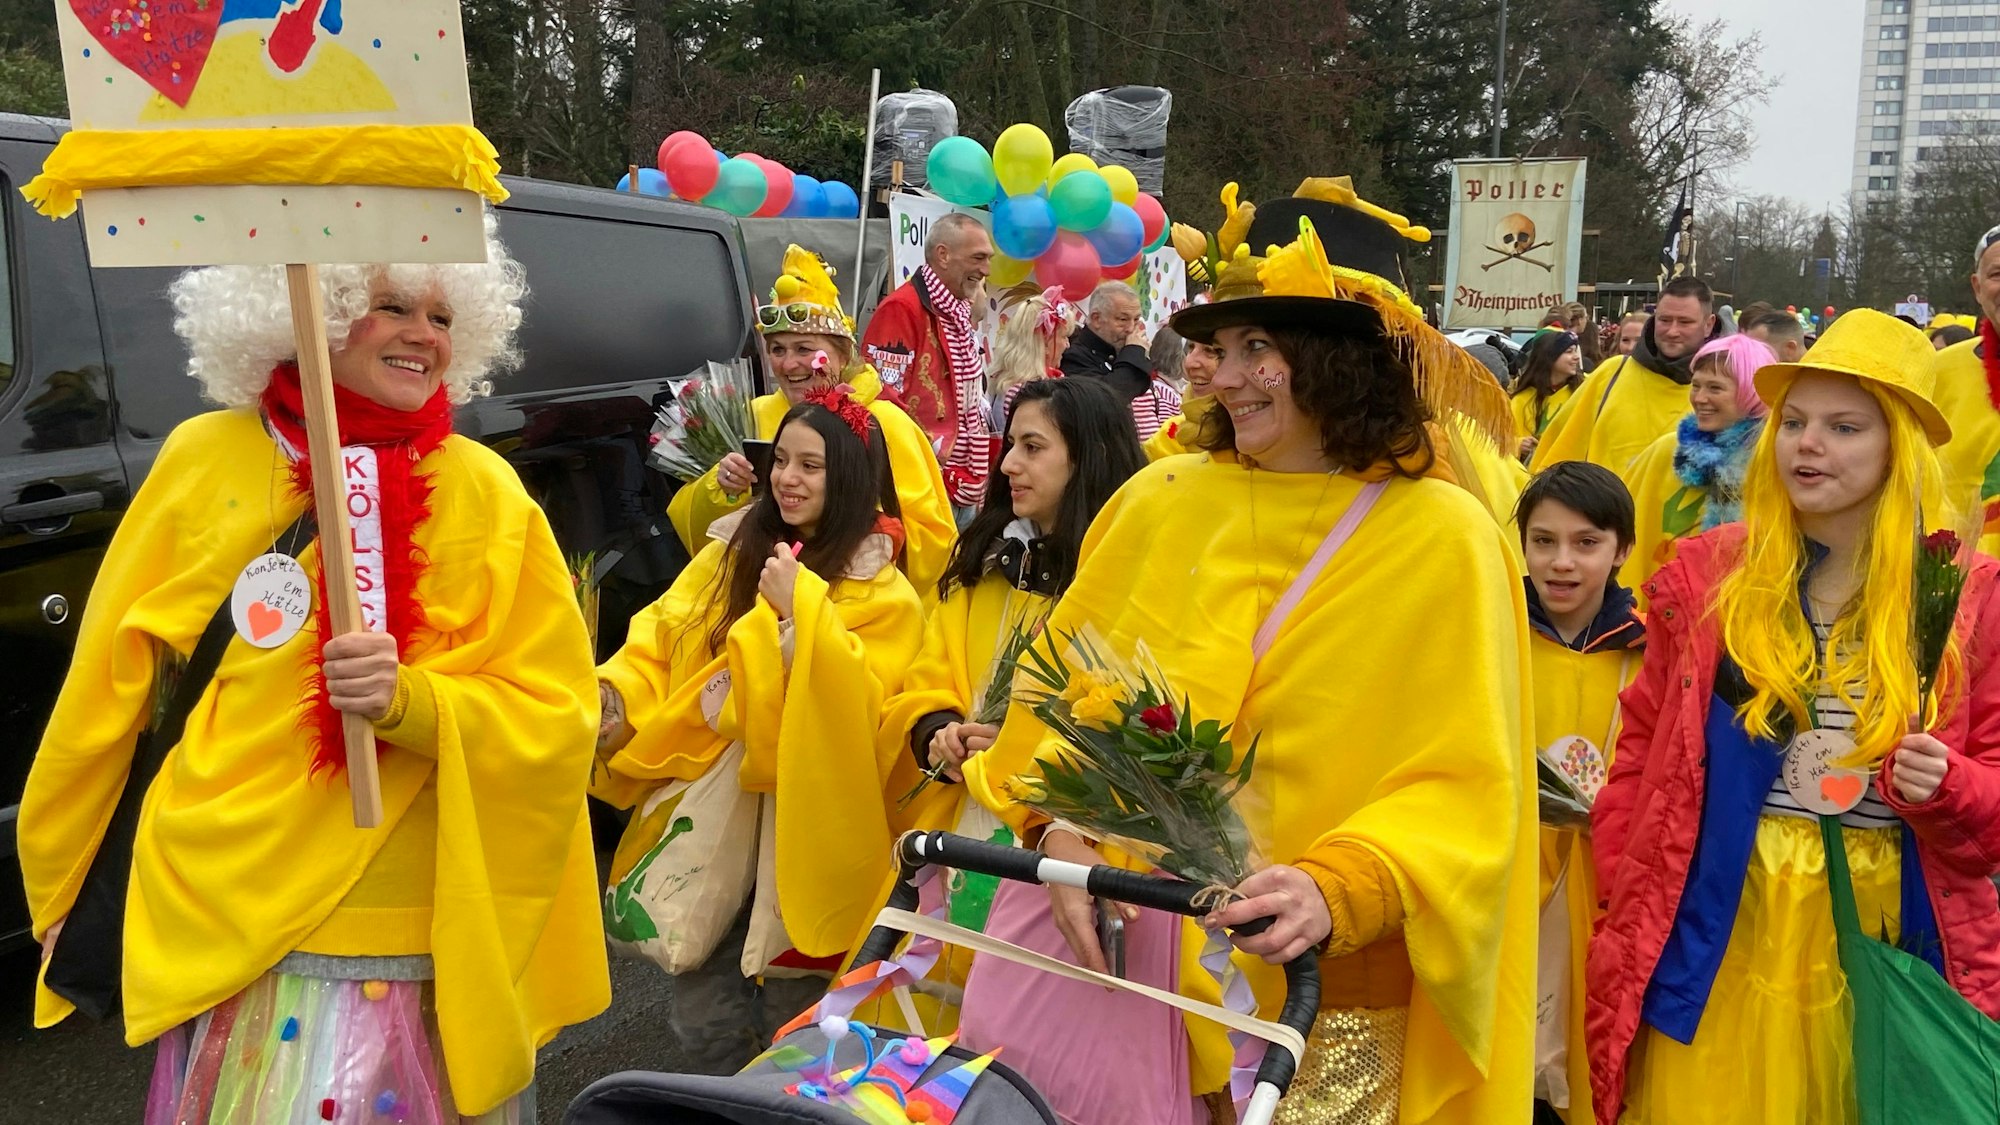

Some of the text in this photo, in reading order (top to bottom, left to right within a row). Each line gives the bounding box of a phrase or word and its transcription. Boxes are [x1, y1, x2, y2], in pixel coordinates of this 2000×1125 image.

[138, 29, 205, 76] Hätze
[1465, 178, 1565, 202] Poller
[1454, 285, 1564, 317] Rheinpiraten
[1263, 371, 1286, 391] Poll
[245, 557, 297, 580] Konfetti
[284, 581, 303, 598] em
[261, 590, 304, 618] Hätze
[1815, 746, 1832, 761] em
